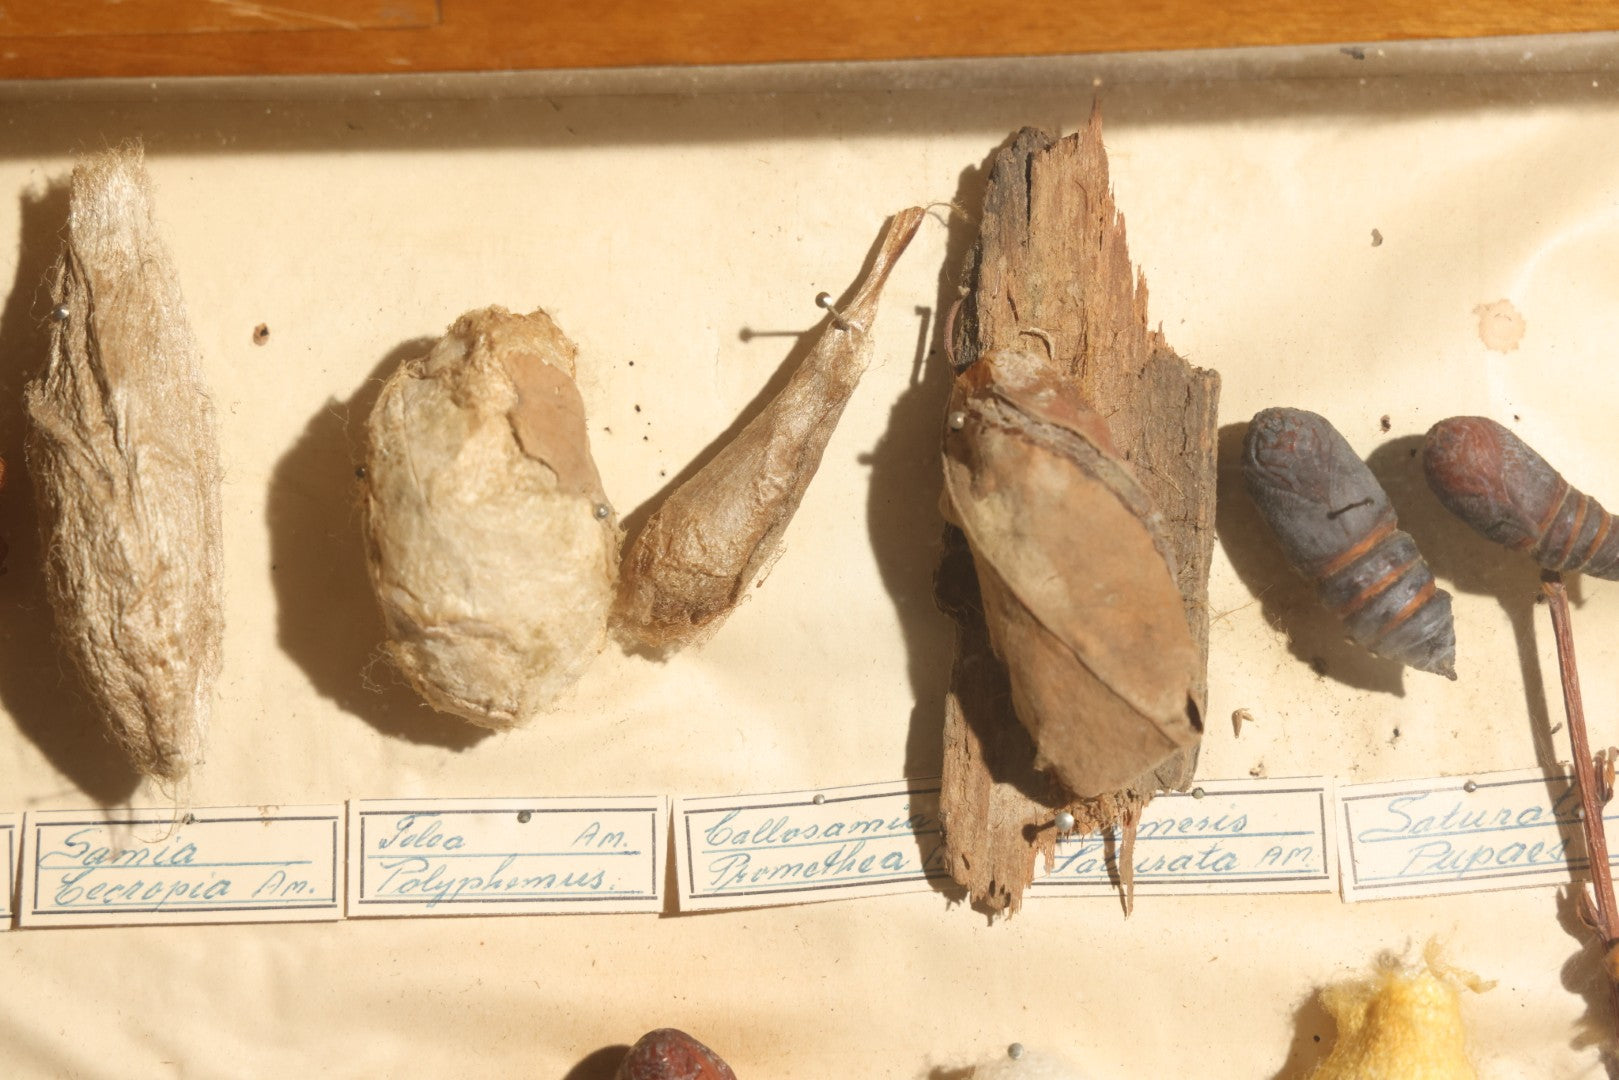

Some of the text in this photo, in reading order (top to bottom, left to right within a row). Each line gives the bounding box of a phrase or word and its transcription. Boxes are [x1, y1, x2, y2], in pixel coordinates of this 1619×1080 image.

[705, 804, 932, 846] Callosamia
[39, 828, 198, 866] Samia
[709, 840, 910, 892] Promethea
[55, 868, 231, 910] Cecropia
